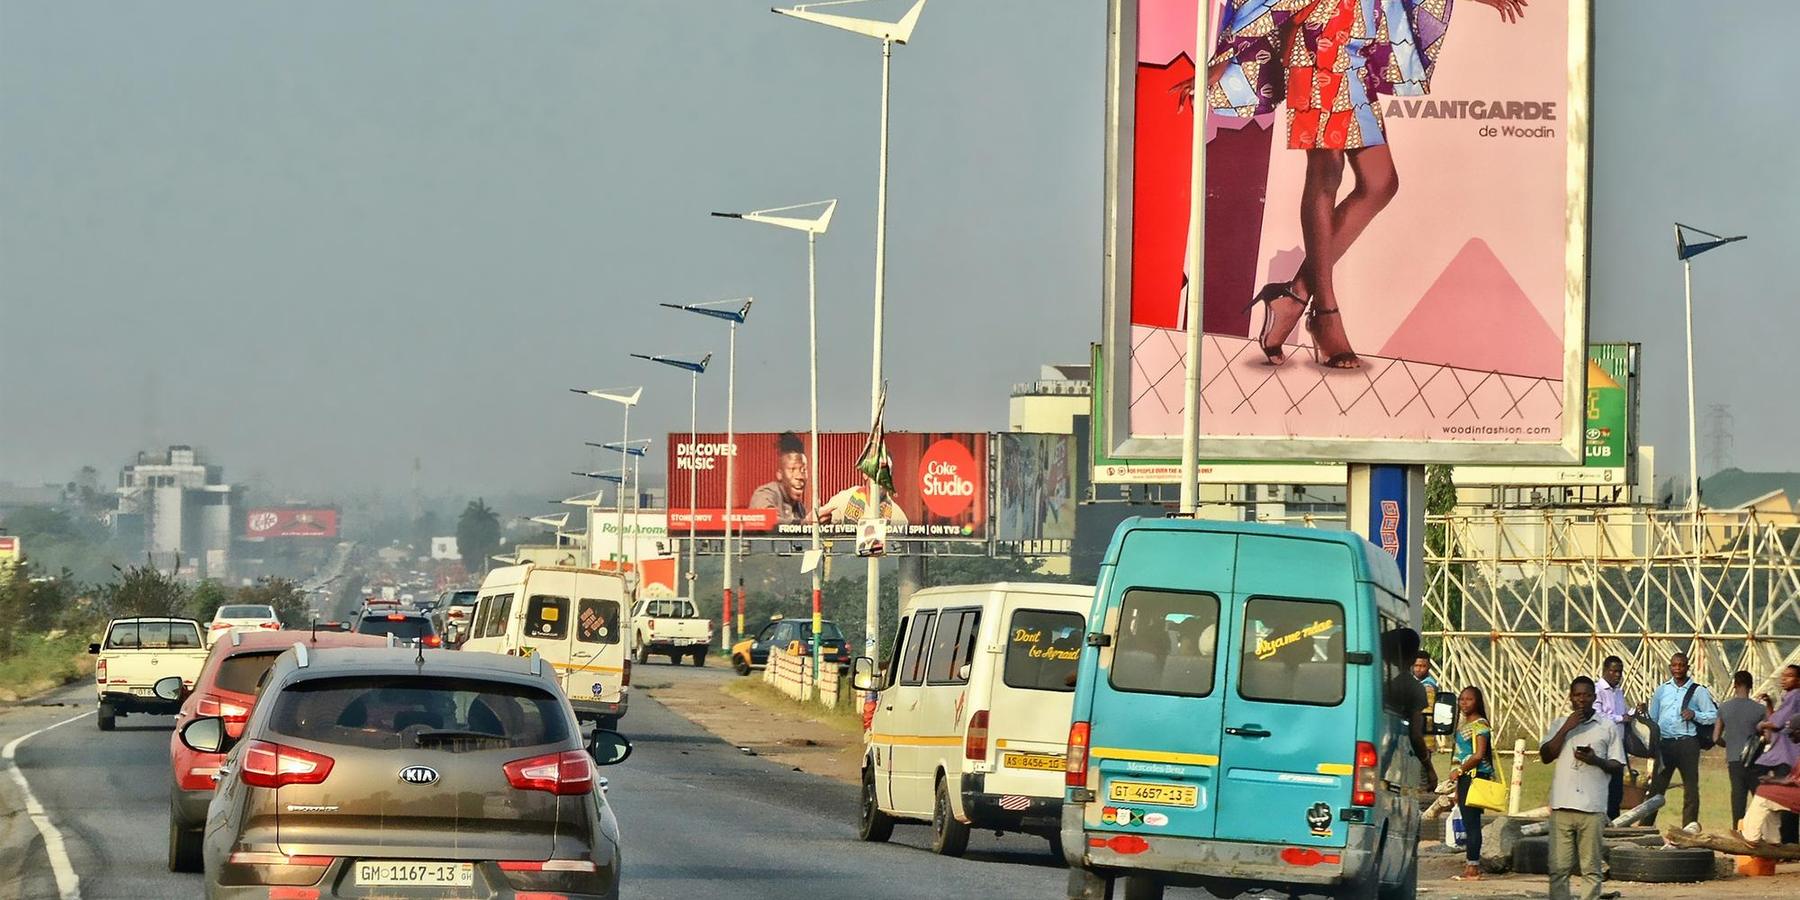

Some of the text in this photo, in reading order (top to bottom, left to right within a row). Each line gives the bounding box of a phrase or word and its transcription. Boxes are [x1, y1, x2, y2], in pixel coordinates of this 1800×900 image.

[1385, 100, 1557, 121] AVANTGARDE
[1479, 125, 1555, 138] de Woodin
[1442, 425, 1551, 434] woodinfashion.com
[677, 443, 737, 456] DISCOVER
[677, 457, 715, 470] MUSIC
[928, 461, 957, 476] Coke
[924, 474, 974, 496] Studio
[602, 523, 632, 535] Roal
[778, 524, 801, 533] FROM
[908, 524, 926, 534] 5PM
[930, 524, 944, 534] ON
[944, 525, 960, 534] TV3
[406, 768, 433, 781] KIA
[1115, 785, 1182, 801] GT 4657-13
[362, 866, 380, 881] GM
[390, 866, 455, 882] 1167-13
